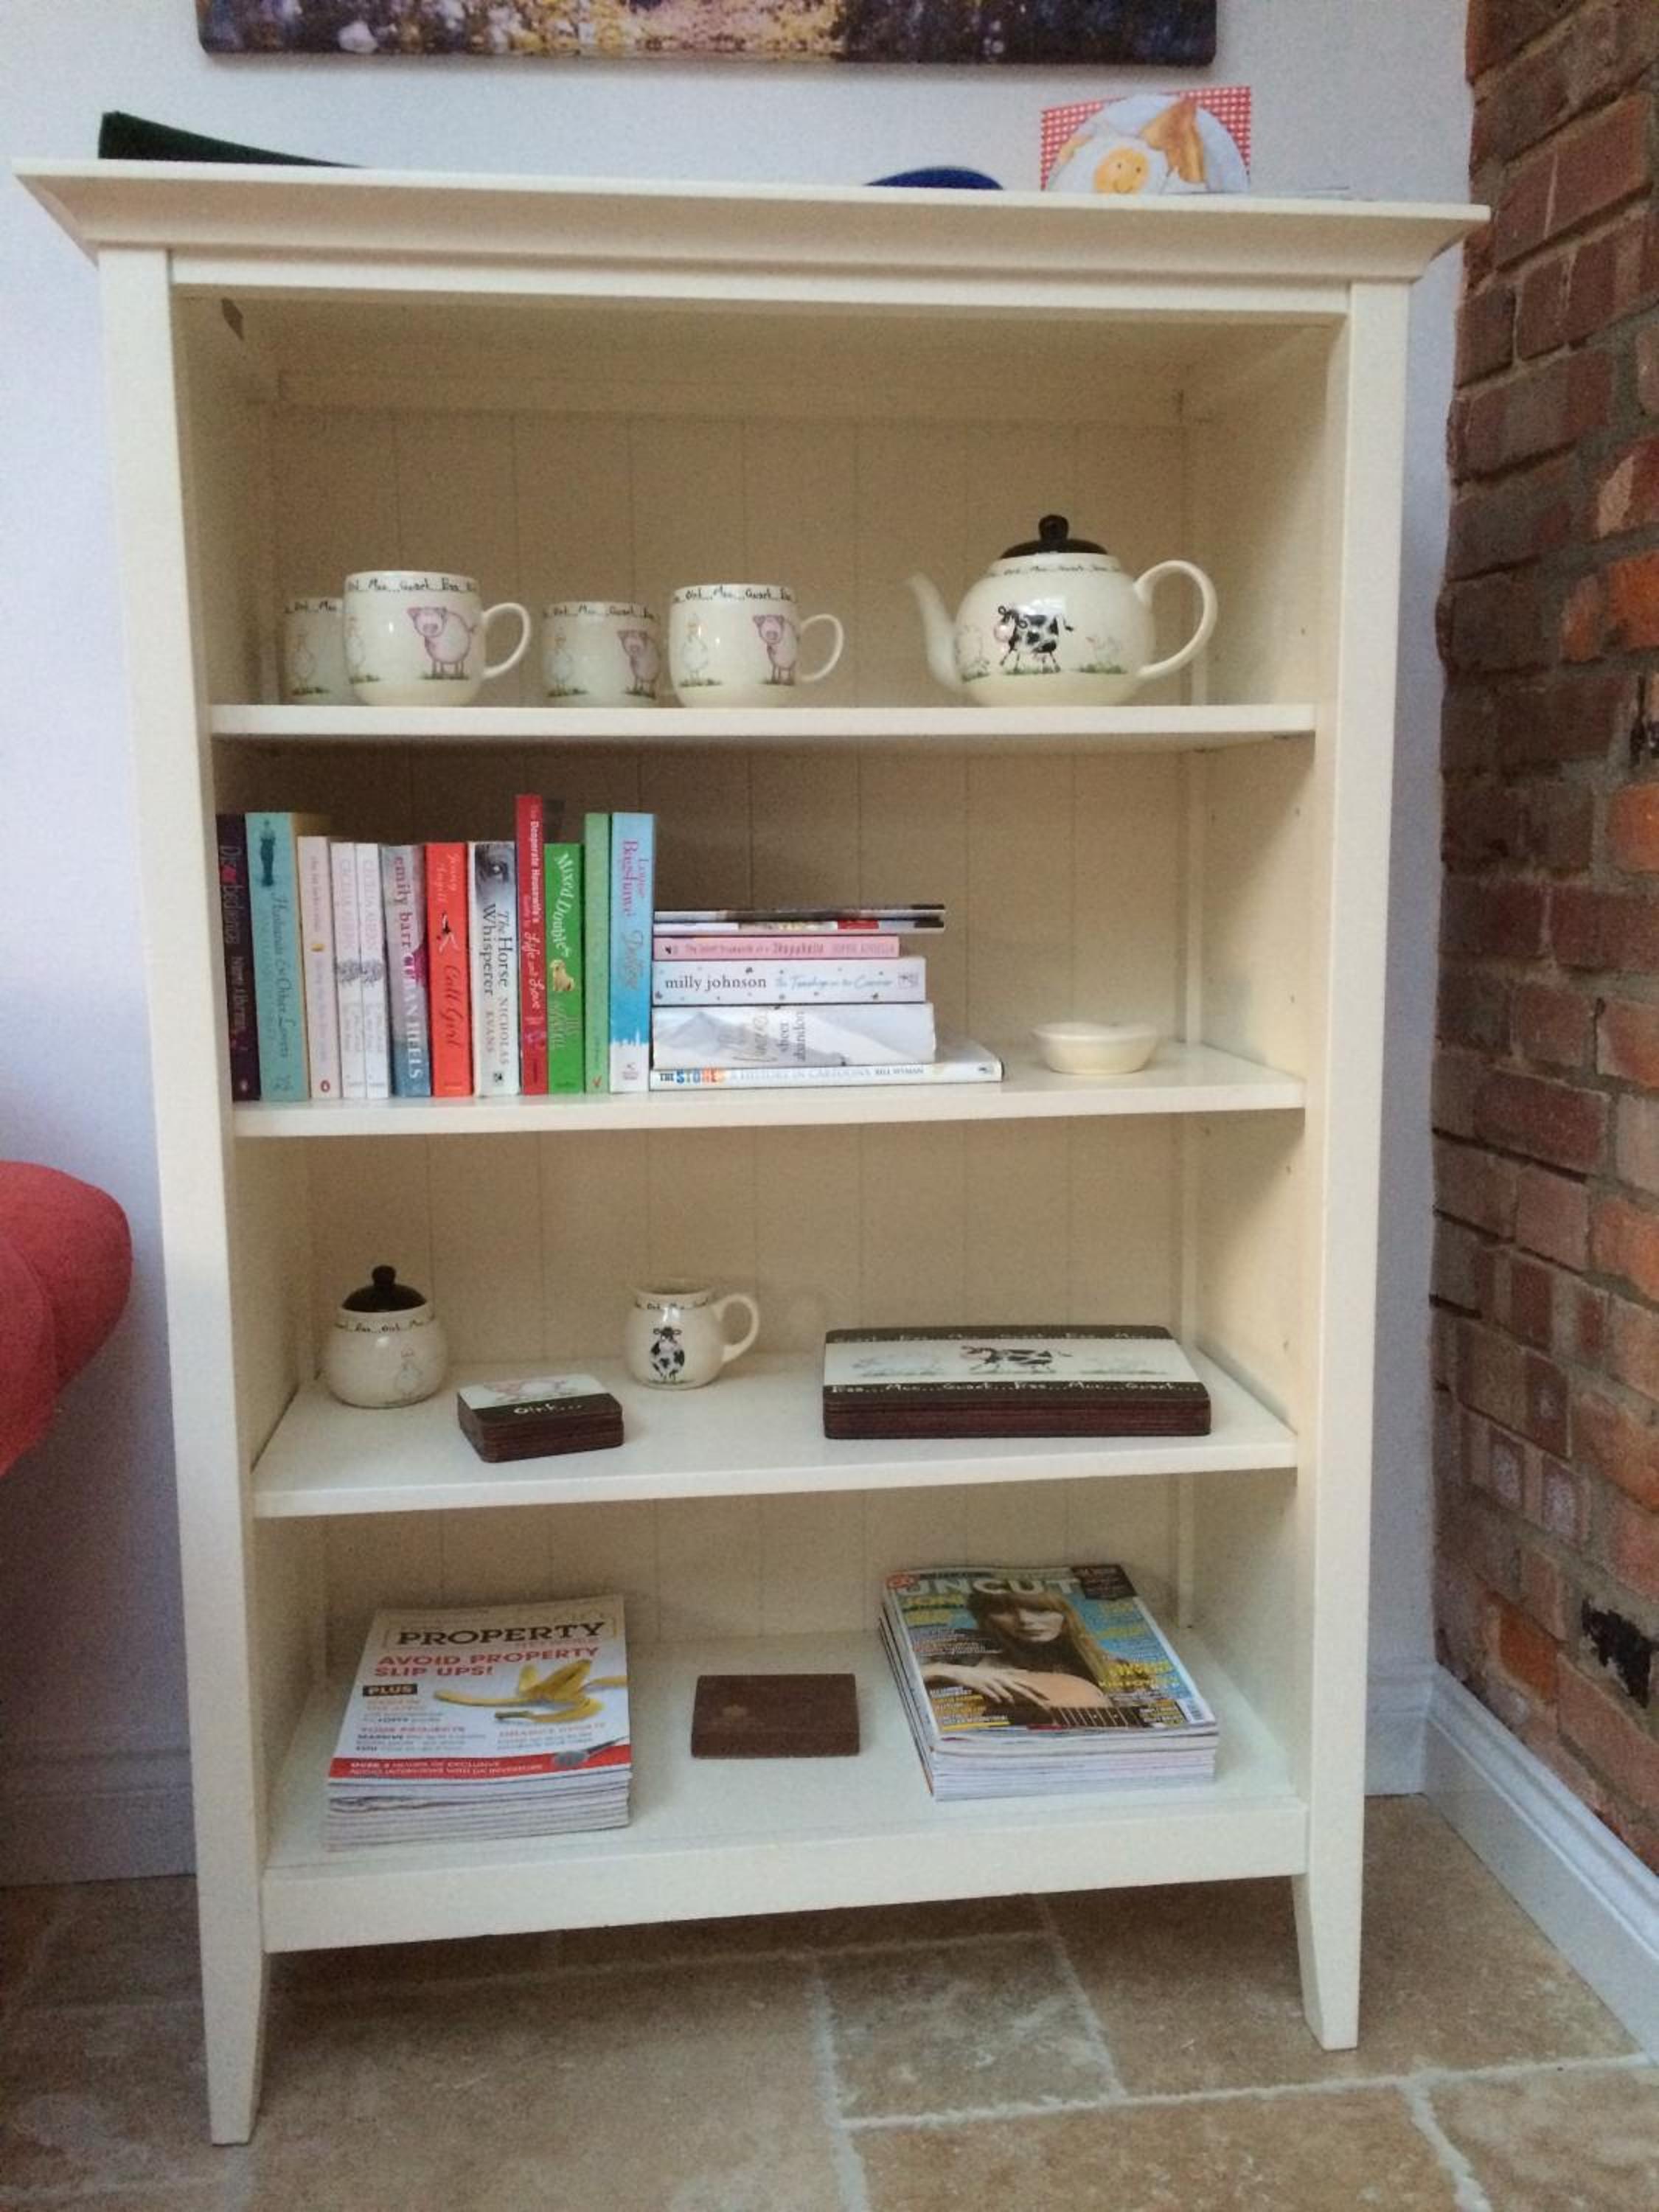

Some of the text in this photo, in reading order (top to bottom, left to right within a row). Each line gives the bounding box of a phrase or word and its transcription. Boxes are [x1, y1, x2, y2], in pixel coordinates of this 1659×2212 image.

[553, 852, 576, 898] Mixed
[393, 855, 414, 948] emily barr
[479, 902, 497, 997] Whisperer
[497, 936, 512, 988] Horse
[665, 975, 703, 990] milly
[705, 975, 767, 992] johnson
[793, 1012, 806, 1062] abandon
[406, 1021, 422, 1079] HEELS
[660, 1073, 674, 1082] THE
[897, 1577, 1081, 1596] UNCUT
[397, 1621, 606, 1646] PROPERTY
[377, 1646, 601, 1666] AVOID PROPERTY
[373, 1665, 494, 1677] SLIP UPS!
[367, 1686, 414, 1695] PLUS
